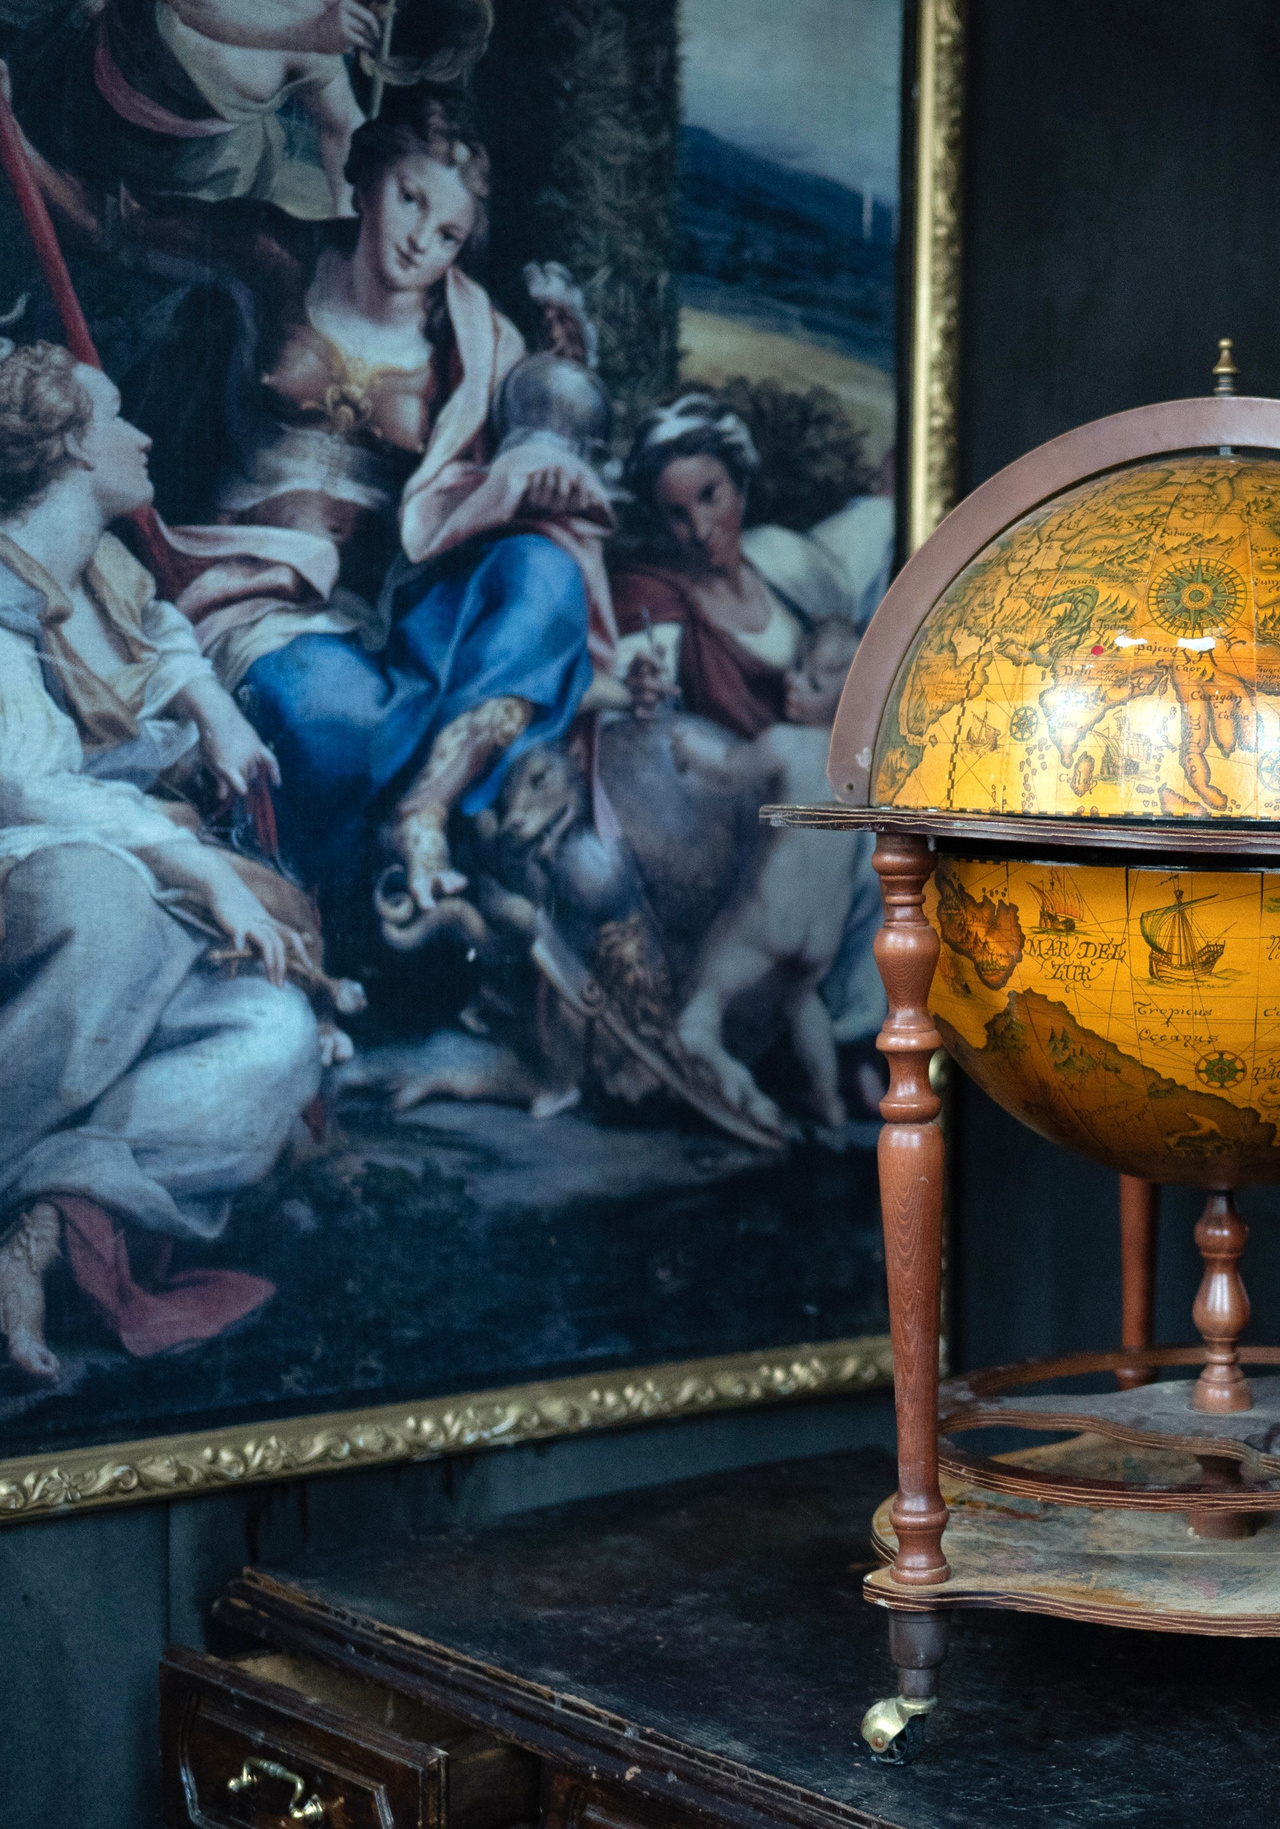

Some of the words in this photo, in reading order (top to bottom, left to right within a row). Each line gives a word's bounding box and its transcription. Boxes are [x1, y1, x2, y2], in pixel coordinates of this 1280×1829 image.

[1023, 935, 1079, 962] MAR
[1076, 937, 1127, 966] DEL
[1045, 961, 1104, 993] ZUR
[1133, 1001, 1212, 1028] Tropicus
[1138, 1027, 1219, 1048] Oceanus
